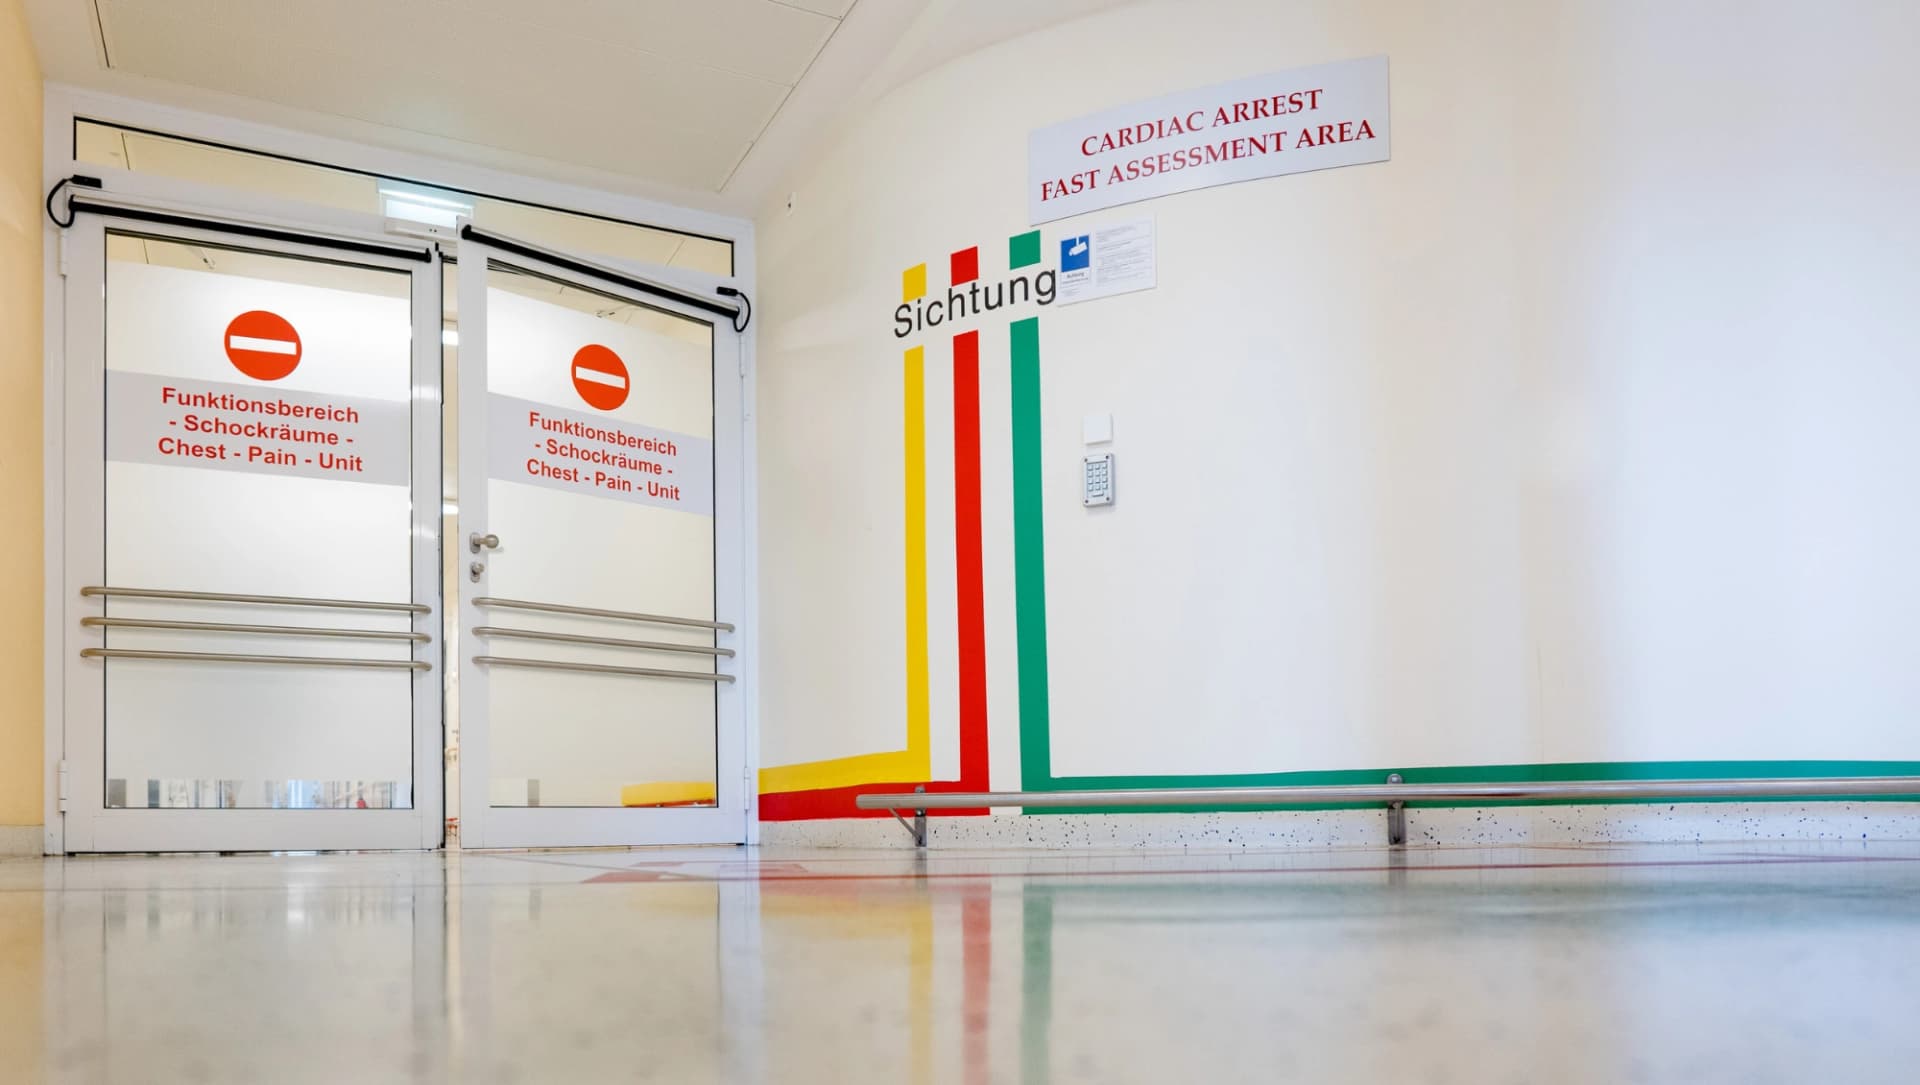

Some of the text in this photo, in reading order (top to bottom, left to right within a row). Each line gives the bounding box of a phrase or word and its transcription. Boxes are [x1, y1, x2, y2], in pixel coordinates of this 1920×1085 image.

[1081, 88, 1324, 156] CARDIAC ARREST
[1041, 119, 1377, 202] FAST ASSESSMENT AREA
[894, 269, 1057, 338] Sichtung
[161, 386, 359, 424] Funktionsbereich
[183, 413, 339, 446] Schockräume
[529, 411, 677, 457] Funktionsbereich
[157, 436, 226, 460] Chest
[247, 445, 297, 466] Pain
[318, 452, 363, 472] Unit
[546, 438, 663, 475] Schockräume
[526, 458, 579, 483] Chest
[595, 471, 631, 492] Pain
[647, 481, 680, 501] Unit
